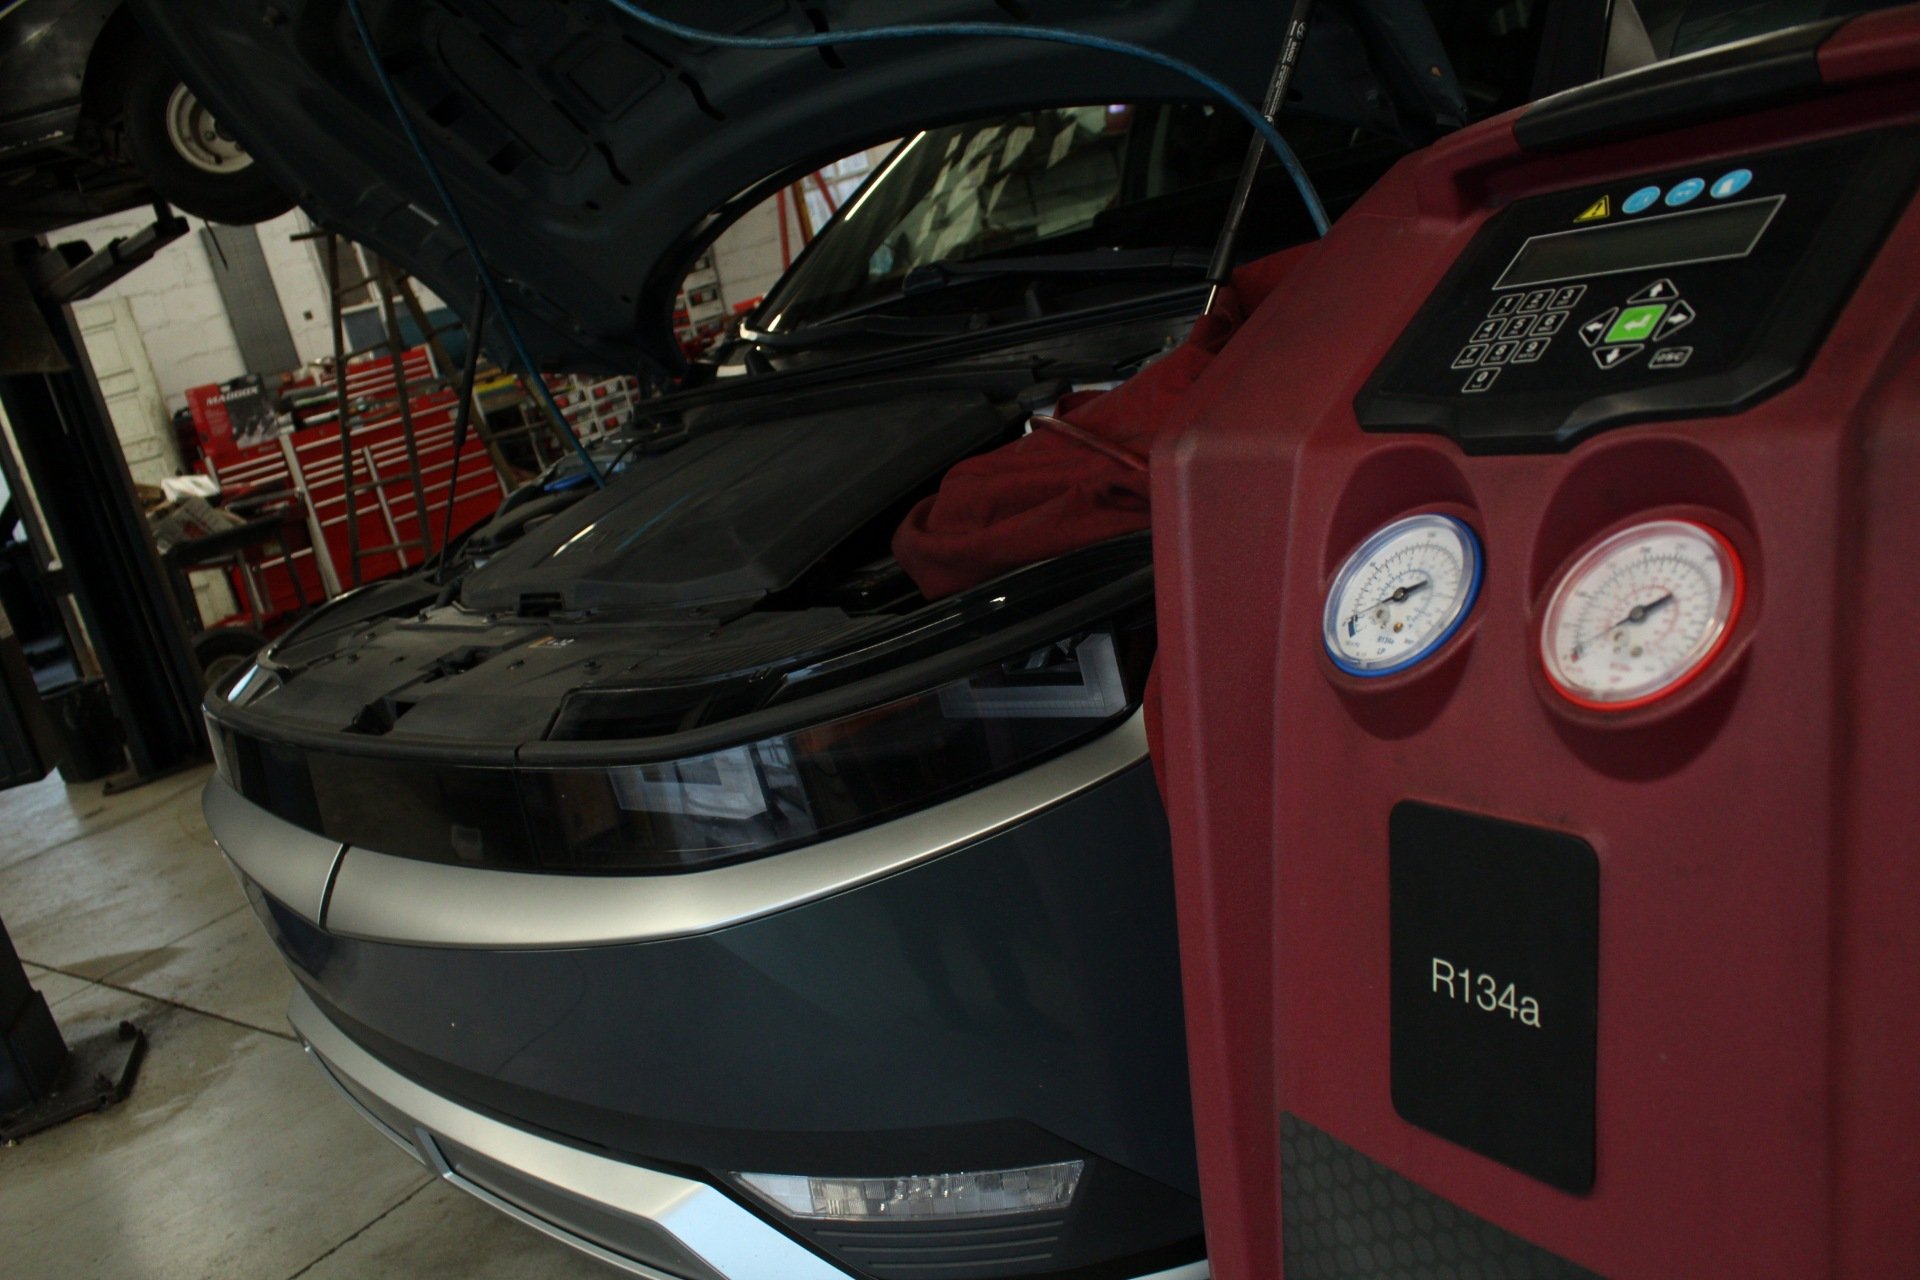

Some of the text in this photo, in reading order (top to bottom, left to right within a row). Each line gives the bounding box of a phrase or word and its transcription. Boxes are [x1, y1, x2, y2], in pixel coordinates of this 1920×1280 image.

[1504, 297, 1513, 308] 1
[1531, 293, 1544, 304] 2
[1562, 289, 1575, 300] 3
[1483, 322, 1496, 333] 4
[1514, 318, 1527, 329] 5
[1545, 315, 1557, 325] 6
[1466, 347, 1479, 358] 7
[1495, 345, 1507, 355] 8
[1526, 341, 1538, 353] 9
[1476, 371, 1489, 382] 0
[1432, 957, 1541, 1028] R134a
